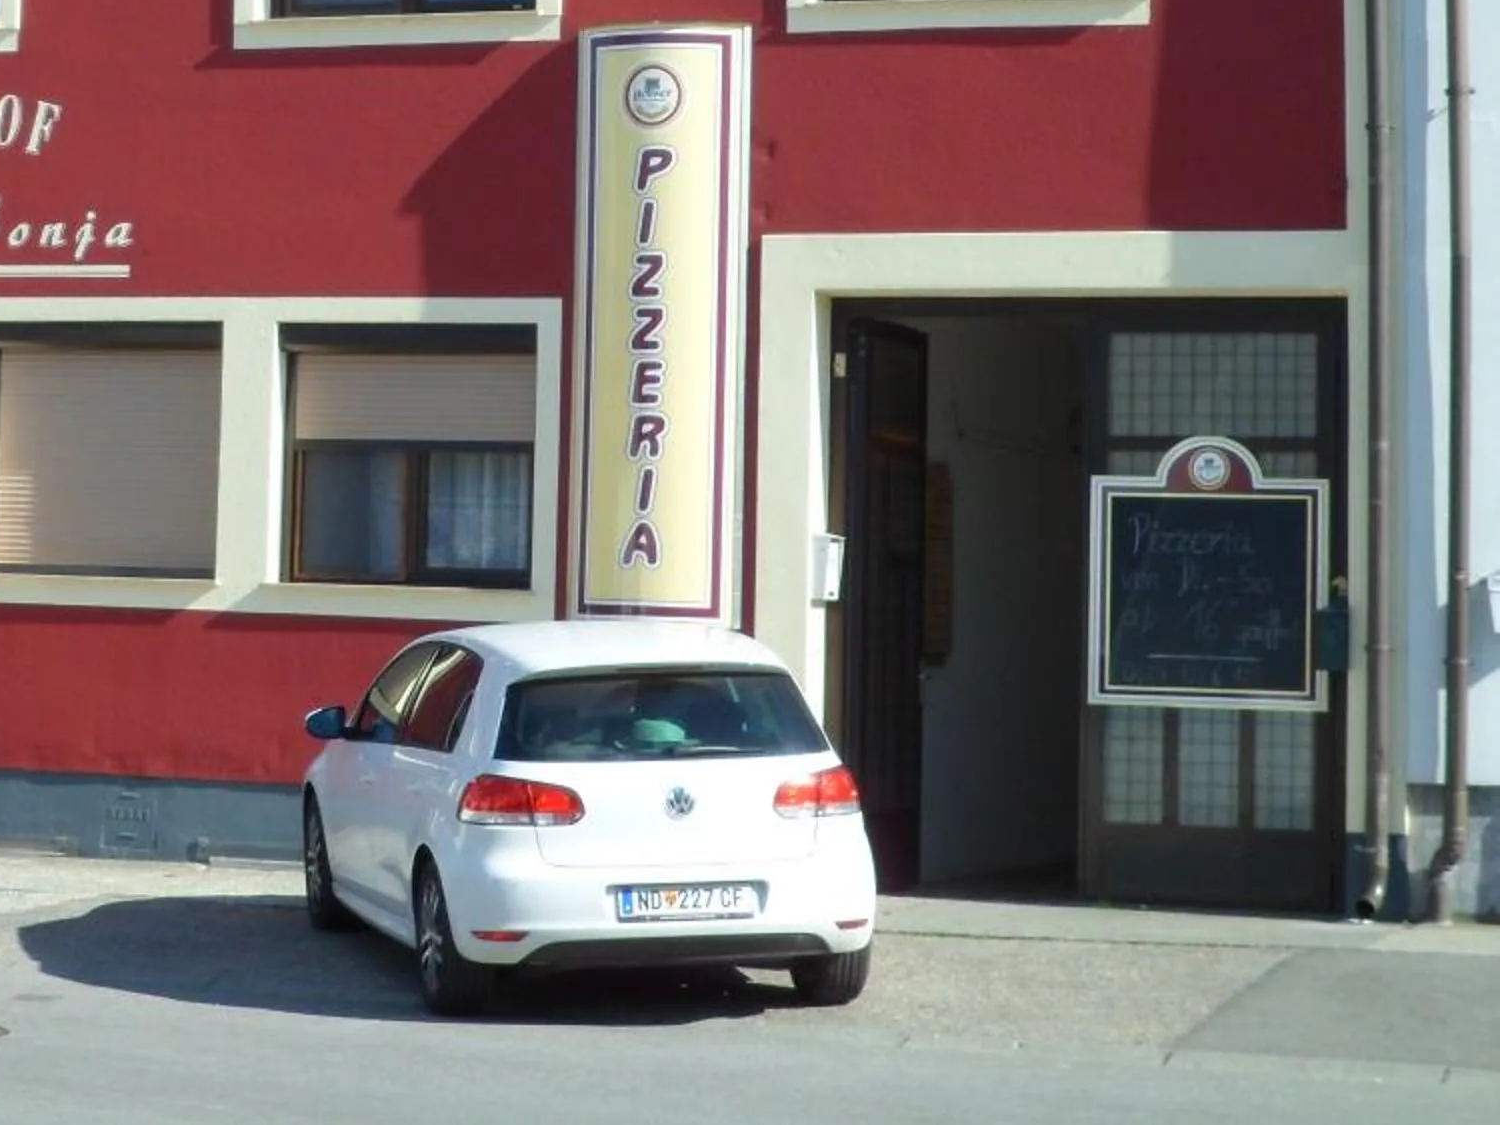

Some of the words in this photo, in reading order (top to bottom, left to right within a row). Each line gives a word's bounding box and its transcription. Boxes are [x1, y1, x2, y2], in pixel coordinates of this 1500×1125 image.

[621, 146, 675, 568] PIZZERIA
[637, 889, 662, 910] ND
[678, 887, 713, 909] 227
[721, 887, 744, 908] CF
